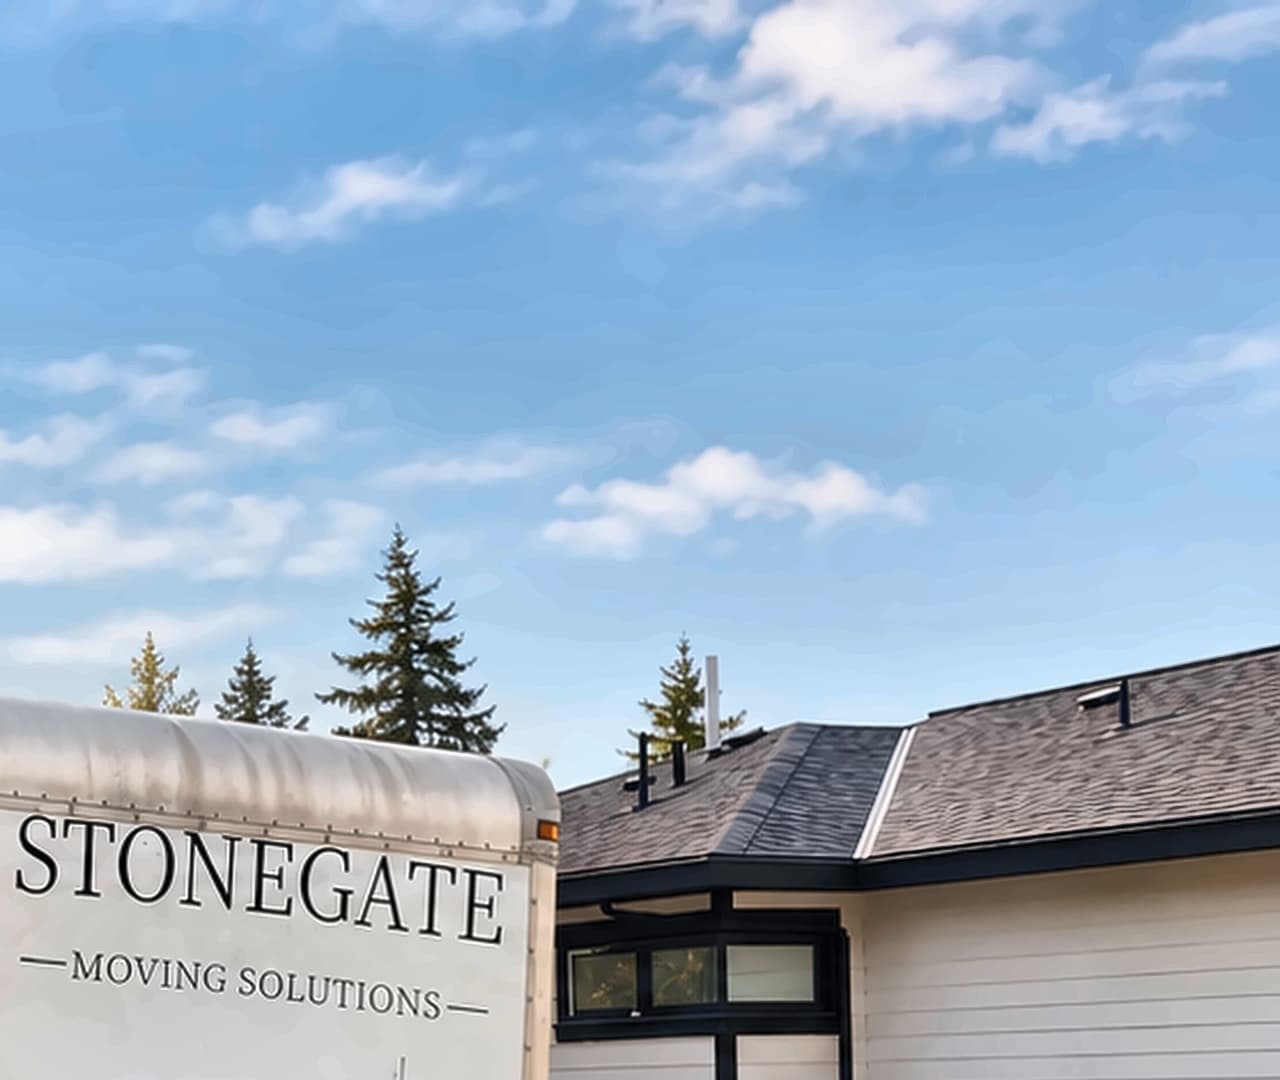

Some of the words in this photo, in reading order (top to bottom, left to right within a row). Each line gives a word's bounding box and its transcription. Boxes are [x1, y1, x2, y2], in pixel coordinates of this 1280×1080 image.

[15, 814, 504, 945] STONEGATE
[71, 950, 228, 994] MOVING
[238, 967, 442, 1020] SOLUTIONS
